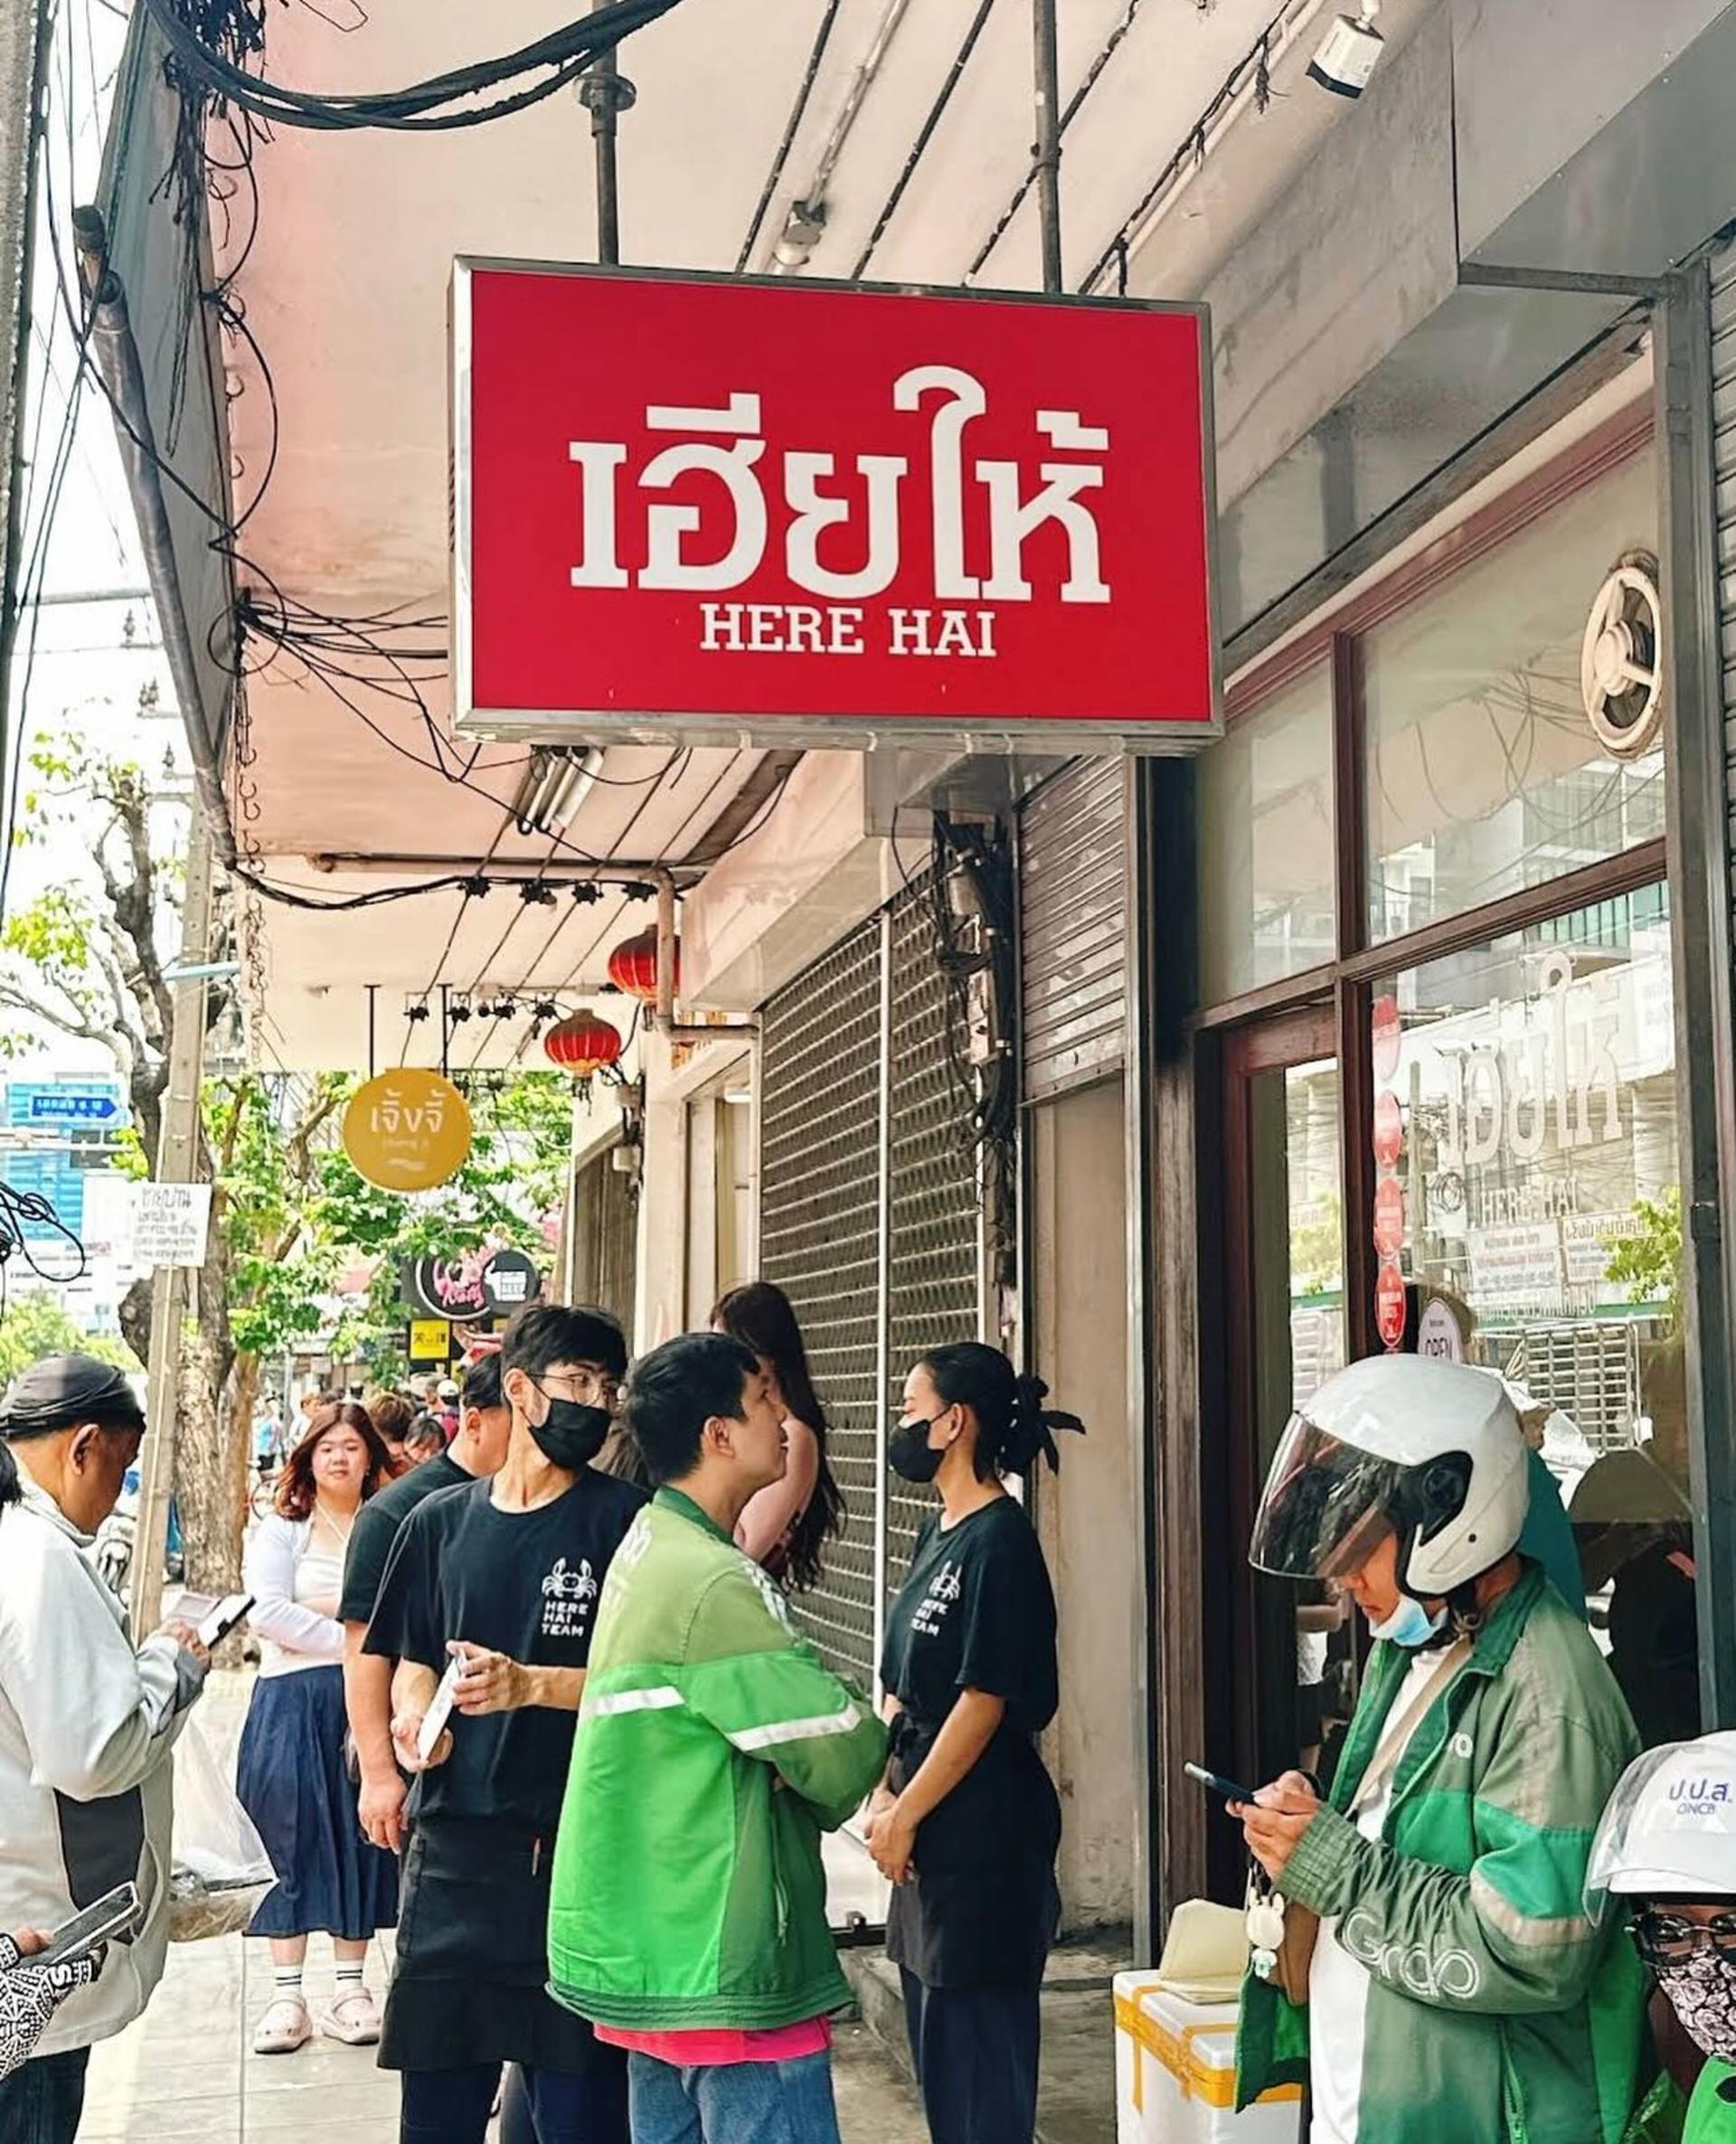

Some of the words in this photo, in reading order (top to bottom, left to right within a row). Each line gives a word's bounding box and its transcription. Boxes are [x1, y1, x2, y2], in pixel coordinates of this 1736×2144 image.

[569, 364, 1111, 604] เฮียให้
[700, 602, 864, 656] HERE
[888, 609, 998, 657] HAI
[544, 1600, 589, 1615] HERE
[543, 1611, 571, 1624] HAI
[542, 1623, 584, 1637] TEAM
[1677, 1802, 1716, 1815] ONCB
[1342, 1906, 1480, 1999] Grab
